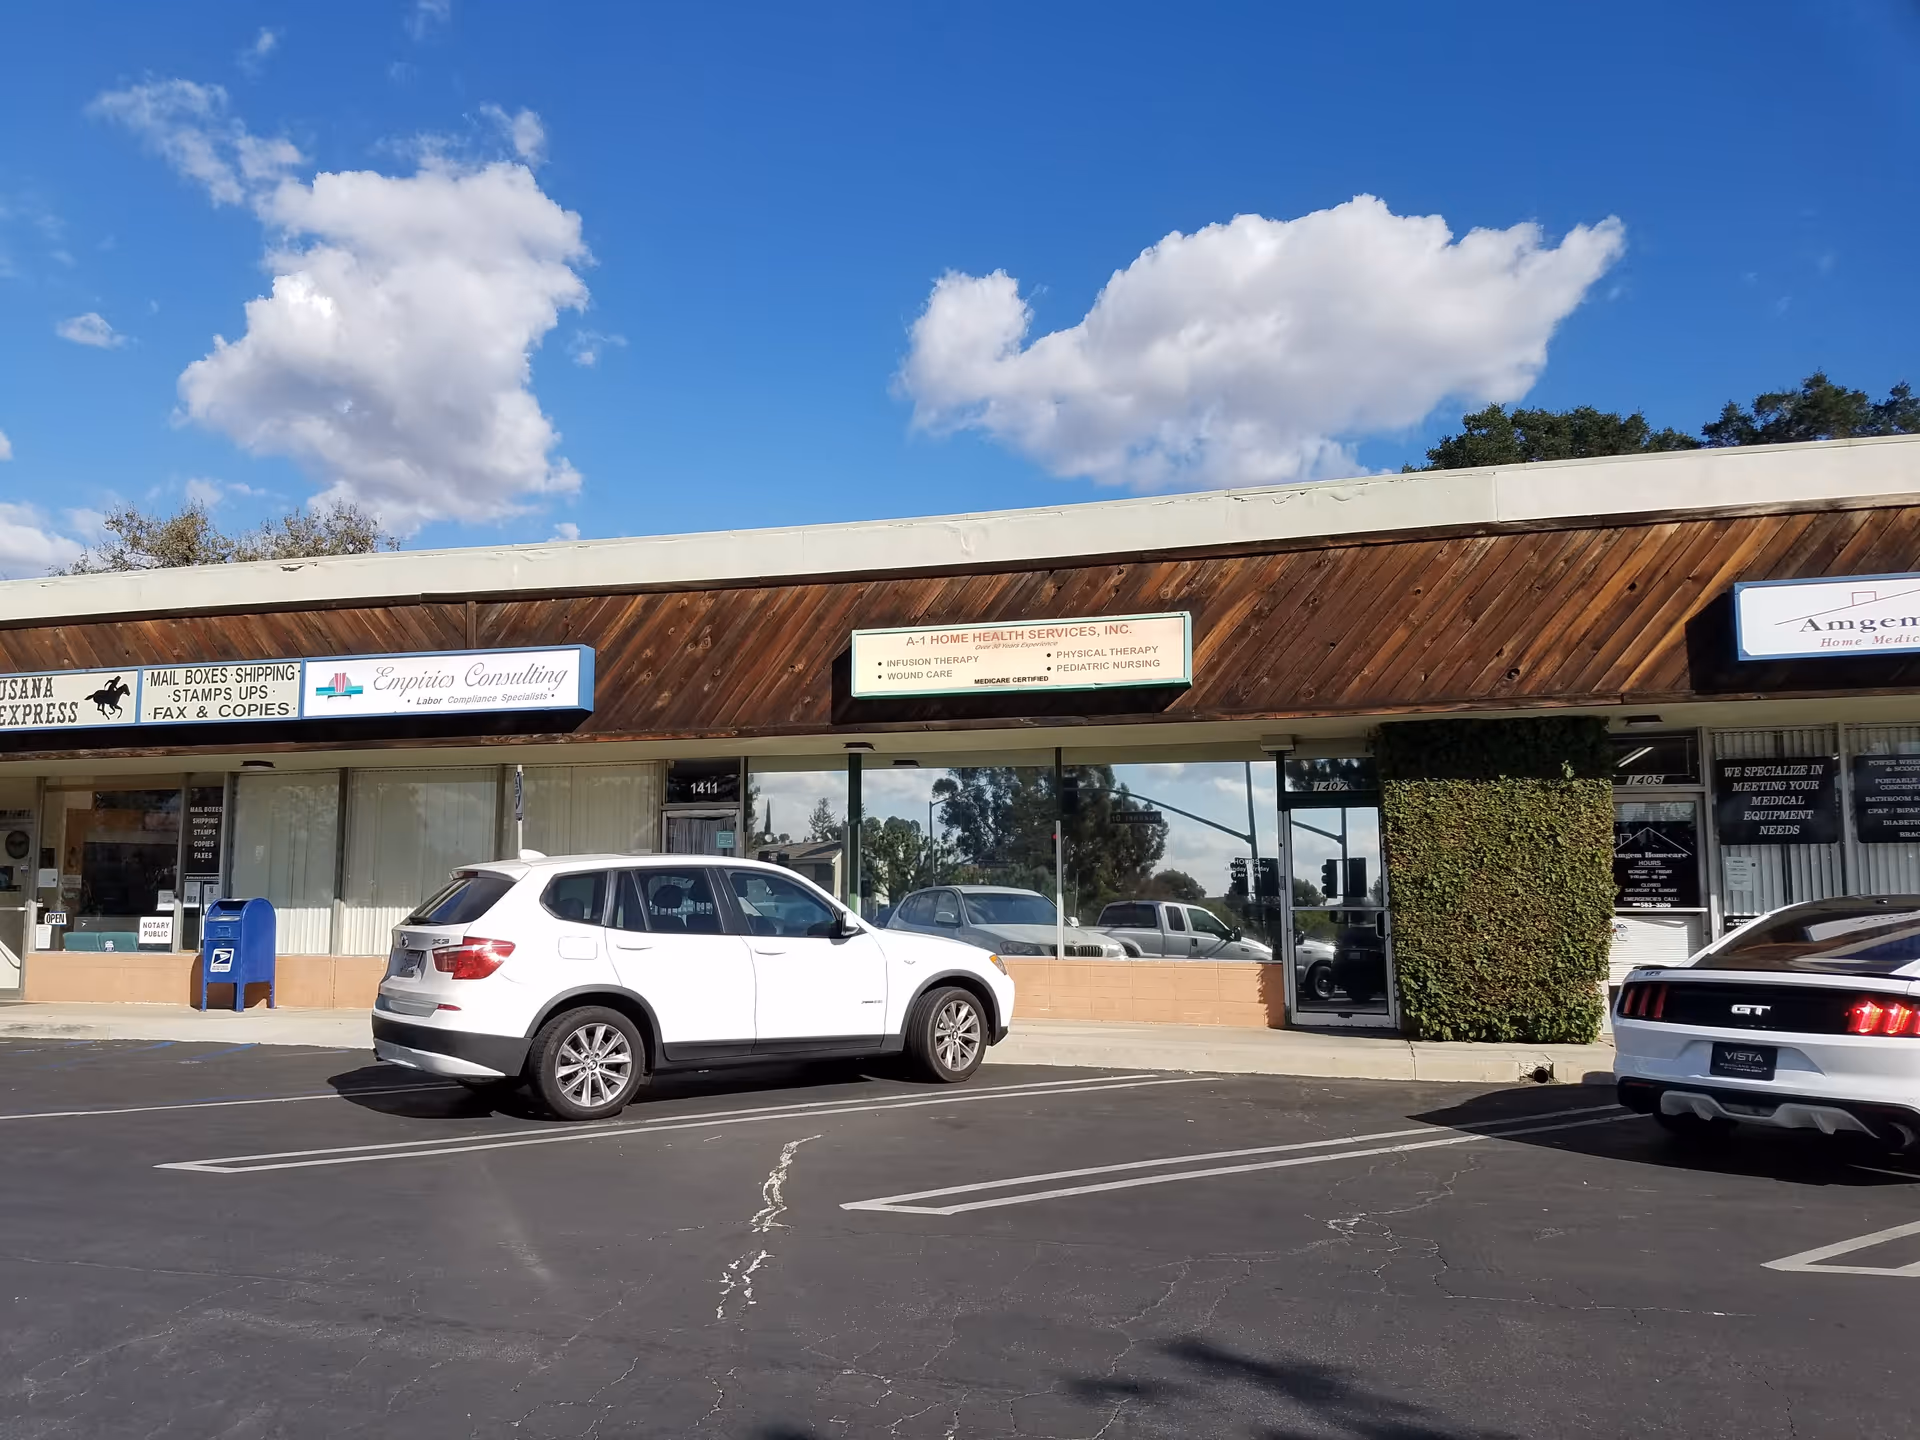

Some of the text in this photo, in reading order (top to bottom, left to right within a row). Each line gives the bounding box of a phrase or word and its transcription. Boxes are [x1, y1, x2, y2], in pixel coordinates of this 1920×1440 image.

[906, 624, 1133, 647] A-1 HOME HEALTH SERVICES, INC.
[1020, 641, 1058, 649] Experience
[1820, 637, 1863, 648] Home
[1056, 646, 1159, 659] PHYSICAL THERAPY
[887, 655, 980, 667] INFUSION THERAPY
[1056, 659, 1160, 672] PEDIATRIC NURSING
[150, 665, 296, 687] MAIL BOXES SHIPPING
[373, 662, 569, 697] Empirics Consulting
[887, 669, 953, 681] WOUND CARE
[974, 675, 1049, 685] MEDICARE CERTIFIED
[239, 685, 269, 700] UPS
[416, 691, 548, 706] Labor Compliance Specialists
[0, 702, 79, 726] EXPRESS
[153, 702, 290, 720] FAX & COPIES
[1724, 764, 1824, 777] WE SPECIALIZE IN
[1629, 775, 1663, 785] 1405
[1732, 780, 1820, 792] MEETING YOUR
[690, 782, 718, 794] 1411
[1315, 781, 1348, 792] 1407
[1751, 796, 1805, 806] MEDICAL
[1743, 810, 1814, 821] EQUIPMENT
[1759, 825, 1801, 835] NEEDS
[46, 913, 66, 924] OPEN
[143, 921, 170, 929] NOTARY
[144, 930, 168, 938] PUBLIC
[1731, 1004, 1771, 1016] GT
[1724, 1051, 1764, 1063] VISTA
